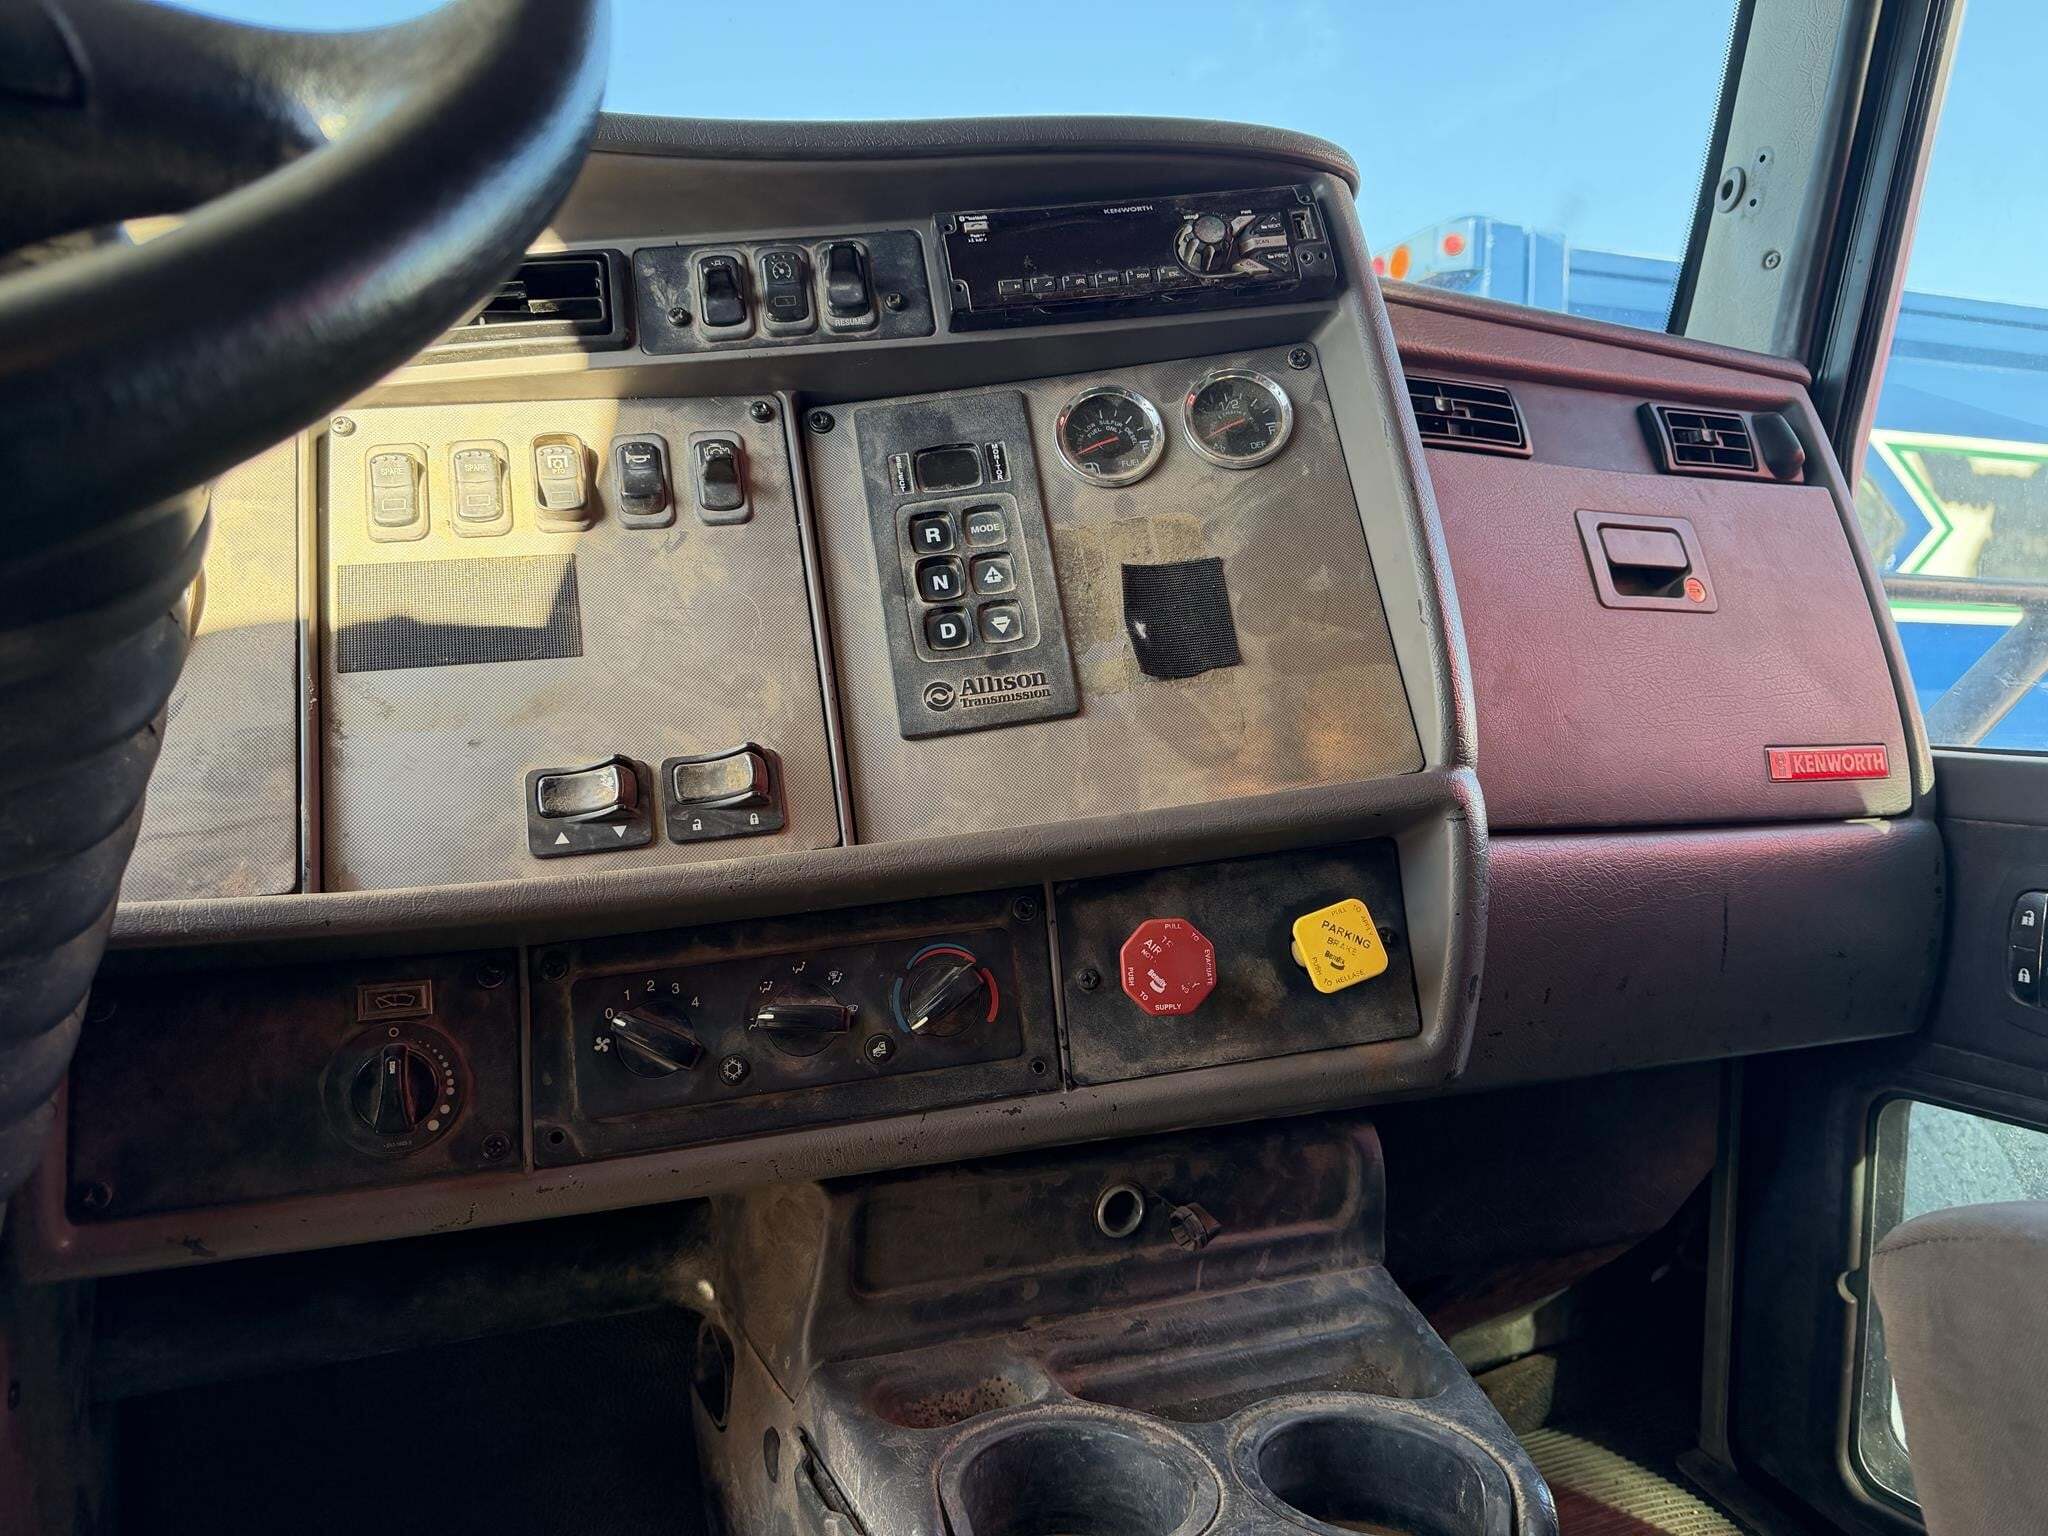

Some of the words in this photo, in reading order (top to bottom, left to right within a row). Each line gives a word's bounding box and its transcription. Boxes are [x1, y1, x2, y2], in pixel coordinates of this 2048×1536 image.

[1103, 205, 1153, 215] KENWORTH
[835, 317, 867, 327] RESUME
[1250, 440, 1267, 450] DEF
[463, 462, 489, 473] SPARE
[991, 443, 1004, 481] MONITOR
[1121, 458, 1140, 468] FUEL
[380, 466, 405, 477] SPARE
[895, 456, 906, 492] SELECT
[970, 523, 1001, 535] MODE
[925, 528, 942, 544] R
[932, 575, 949, 591] N
[939, 623, 957, 639] D
[959, 672, 1049, 697] Allison
[960, 688, 1051, 709] Transmission
[1792, 751, 1885, 774] KENWORTH
[1191, 932, 1200, 942] TO
[1321, 919, 1372, 950] PARKING
[1143, 939, 1163, 956] AIR
[646, 980, 656, 992] 2
[671, 982, 681, 995] 3
[1127, 967, 1135, 987] PUSH
[1139, 990, 1149, 1001] TO
[1154, 1003, 1182, 1011] SUPPLY
[623, 989, 631, 1001] 1
[691, 996, 701, 1008] 4
